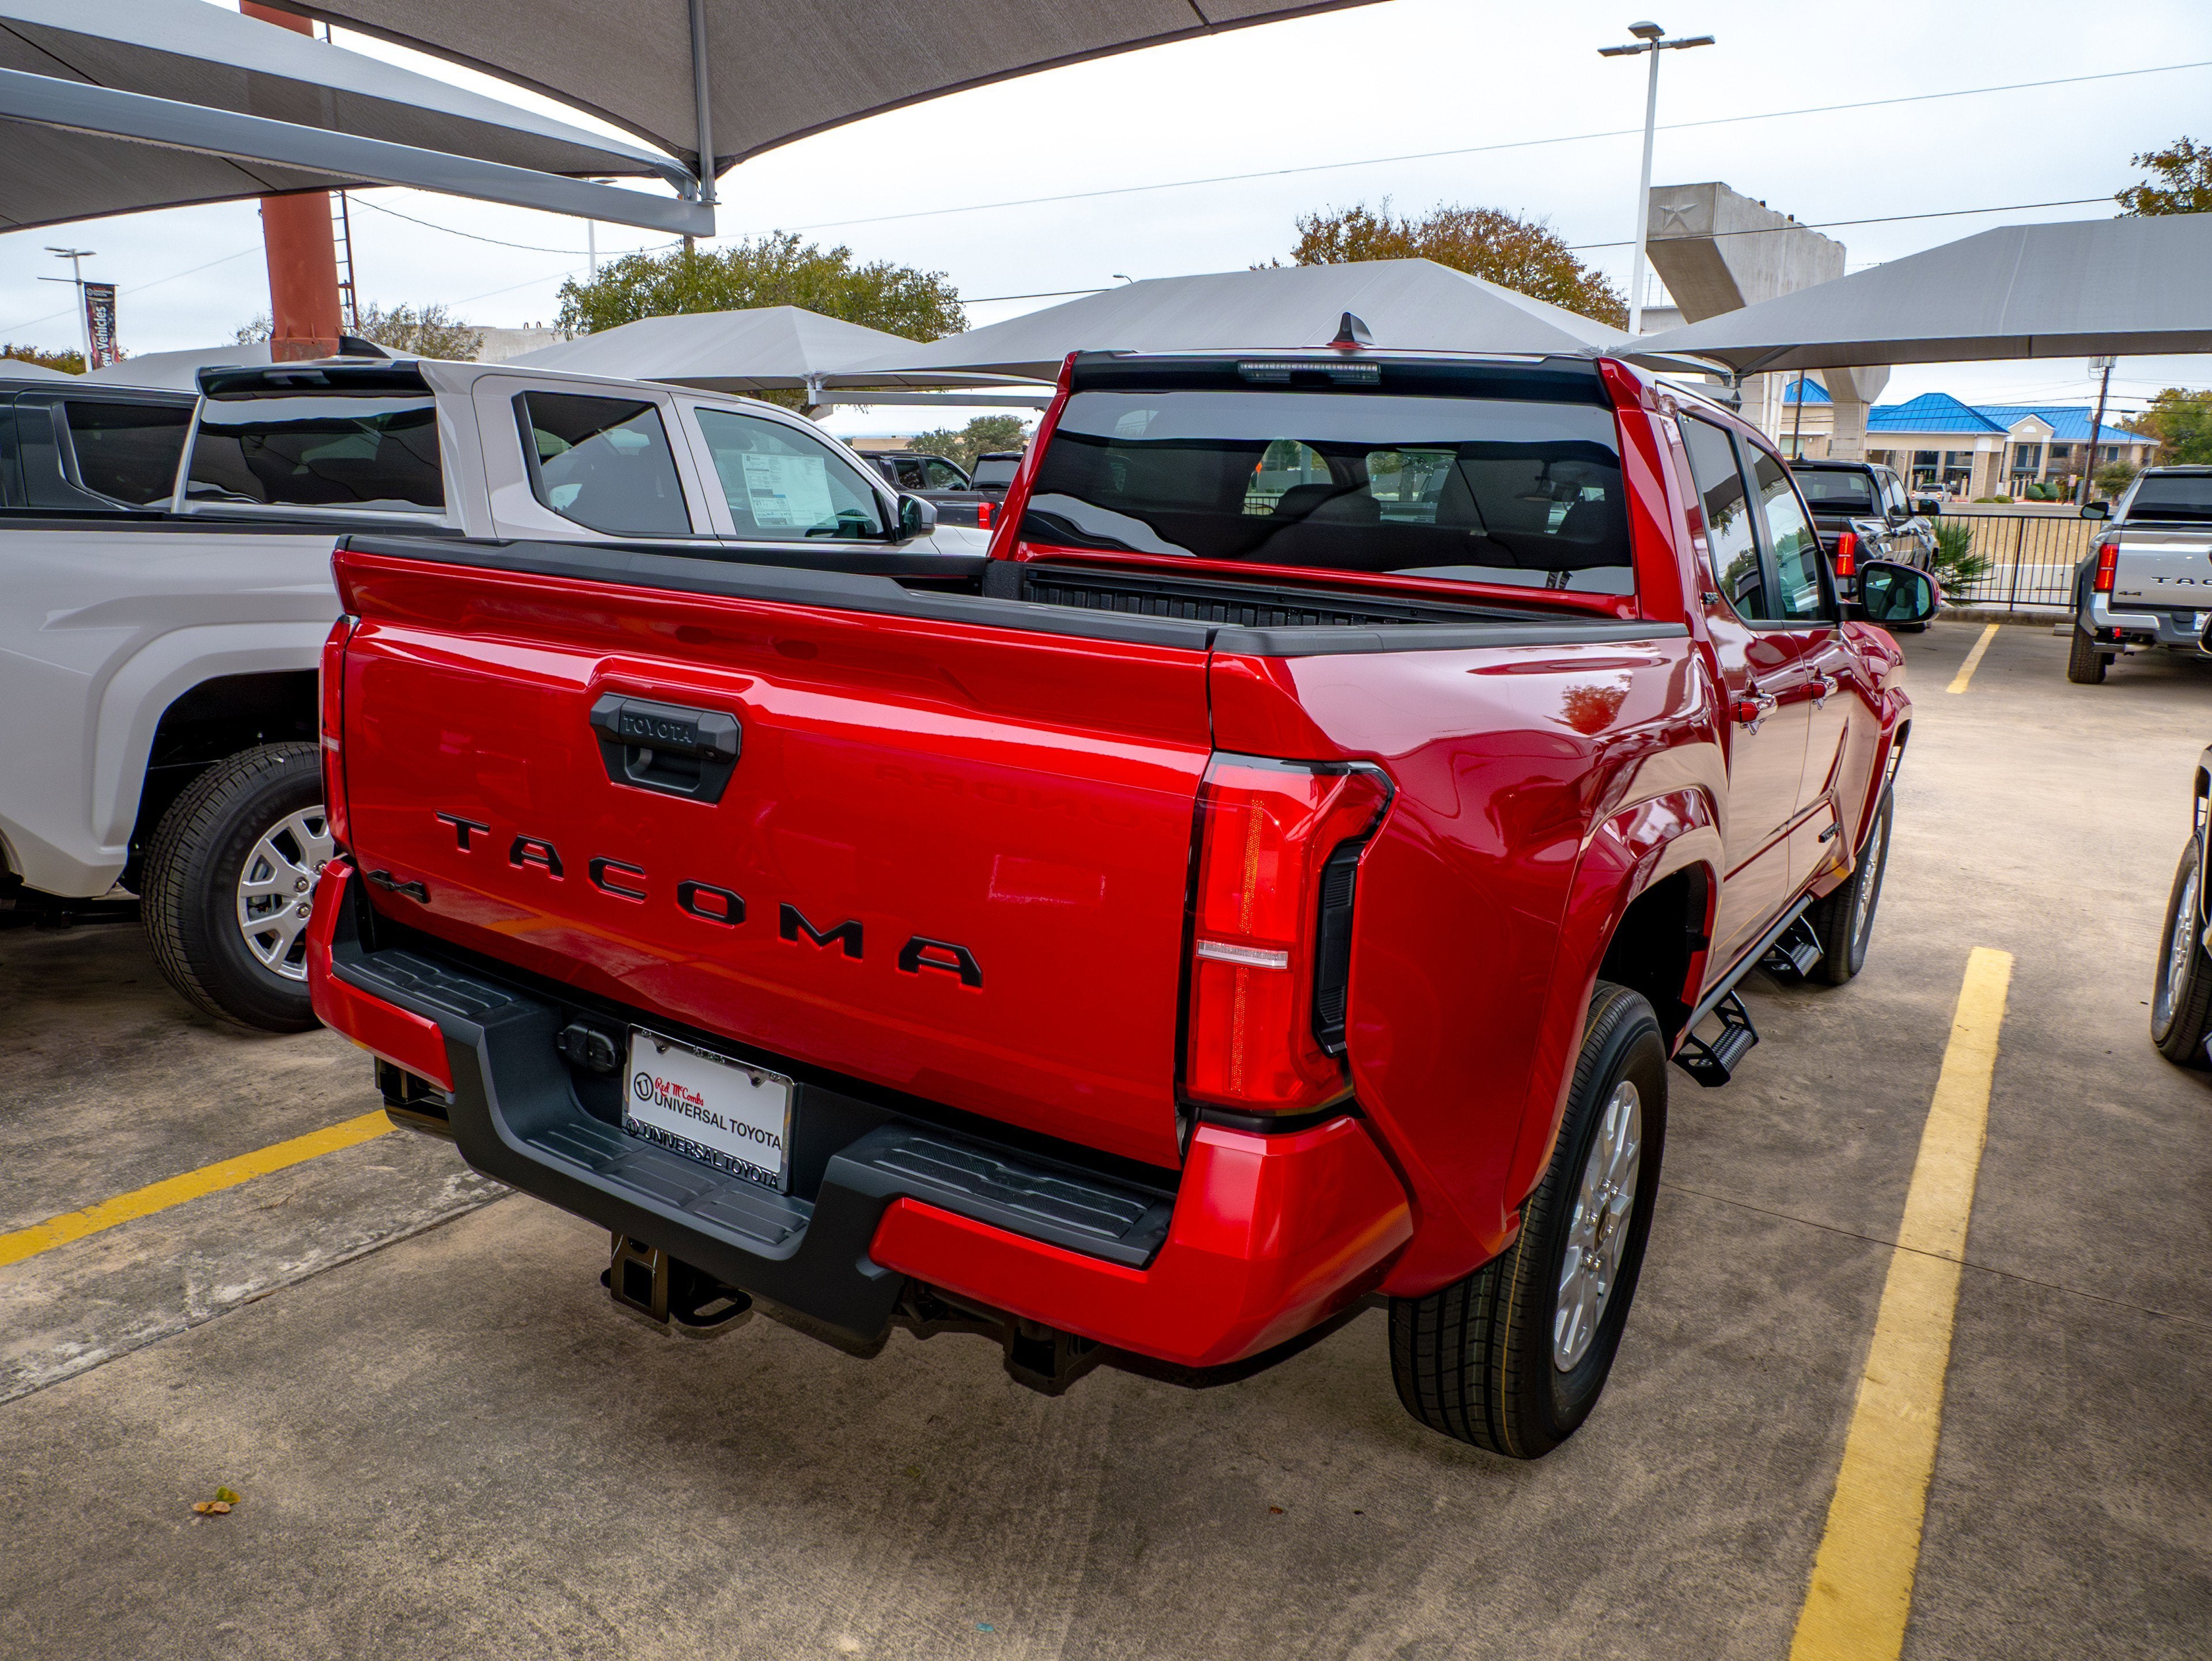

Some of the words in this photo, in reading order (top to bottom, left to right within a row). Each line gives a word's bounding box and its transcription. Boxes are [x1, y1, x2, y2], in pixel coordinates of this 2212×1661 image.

[93, 306, 110, 350] Vehicles
[100, 351, 113, 367] ew
[623, 714, 692, 743] TOYOTA
[434, 810, 983, 992] TACOMA
[655, 1077, 670, 1097] Red
[671, 1083, 704, 1107] McCombs
[654, 1091, 728, 1130] UNIVERSAL
[729, 1118, 782, 1151] TOYOTA
[644, 1123, 722, 1167] UNIVERSAL
[723, 1153, 778, 1190] TOYOTA
